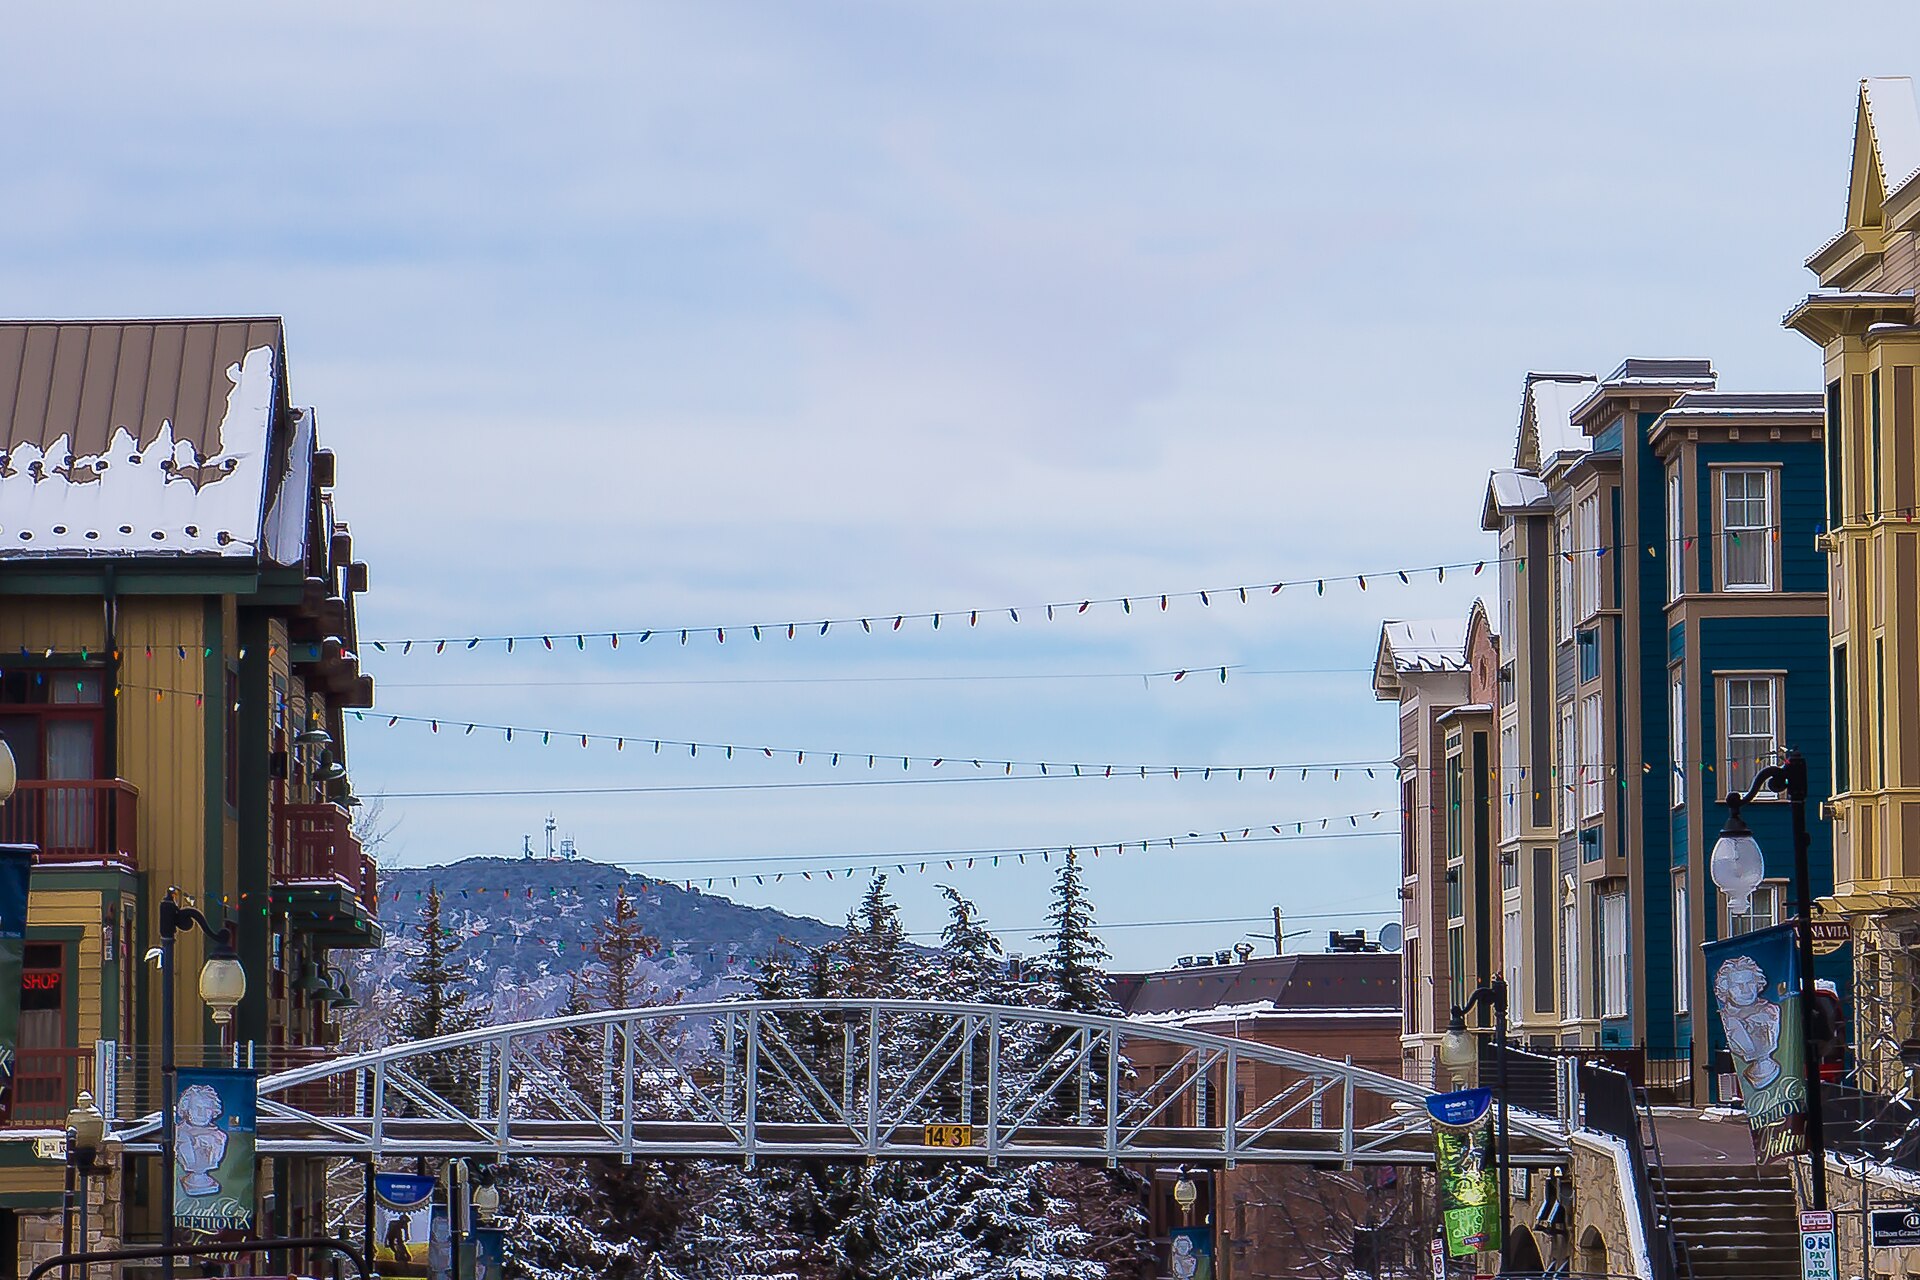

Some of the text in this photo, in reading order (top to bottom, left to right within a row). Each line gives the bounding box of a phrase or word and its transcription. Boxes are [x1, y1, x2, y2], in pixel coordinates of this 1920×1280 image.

[1826, 925, 1850, 937] VITA
[23, 969, 59, 989] SHOP
[1875, 1230, 1898, 1238] Hilton
[1809, 1251, 1826, 1259] PAY
[1813, 1260, 1825, 1268] TO
[1807, 1269, 1831, 1278] PARK
